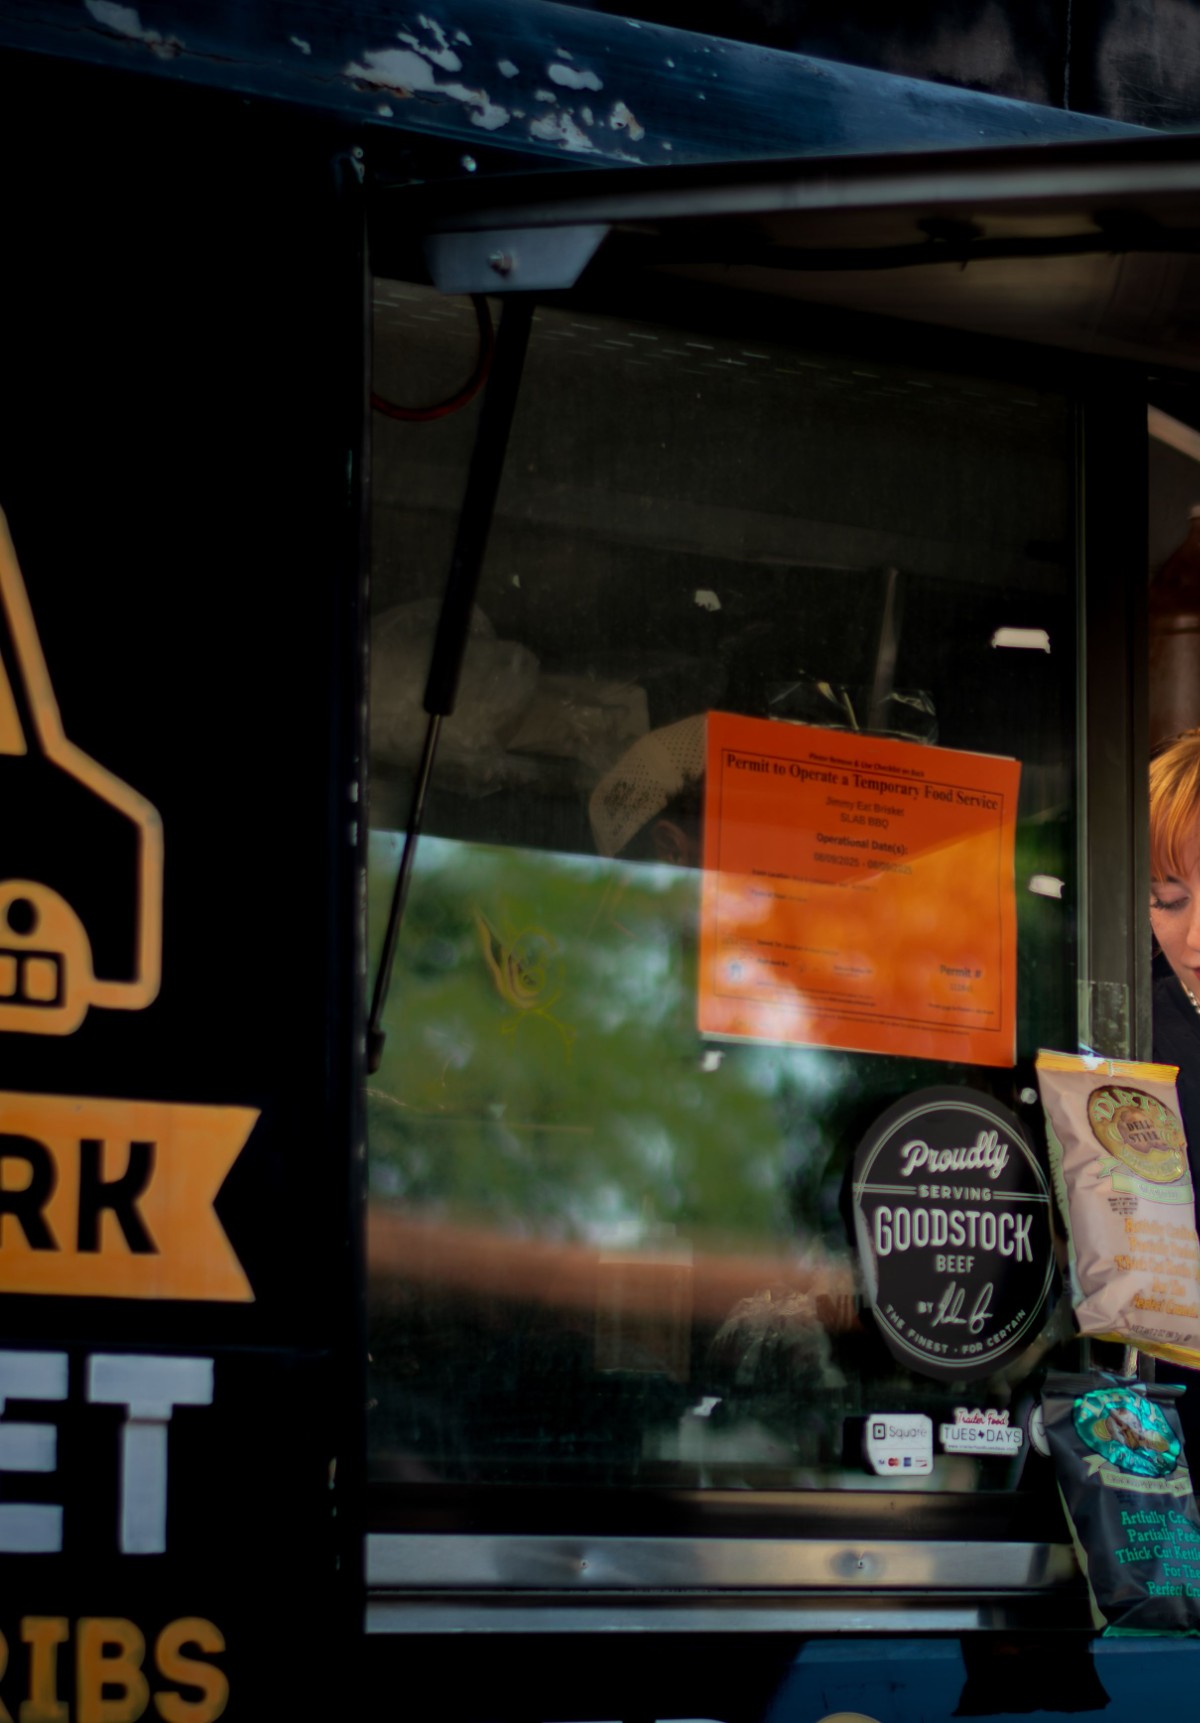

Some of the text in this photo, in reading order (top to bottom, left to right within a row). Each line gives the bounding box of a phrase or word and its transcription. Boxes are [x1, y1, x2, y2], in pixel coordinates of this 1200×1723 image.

[727, 754, 998, 810] Permit to Operate a Temporary Food Service
[857, 801, 872, 812] Eat
[874, 803, 905, 816] Brisket
[840, 813, 889, 829] SLAB BBQ
[816, 832, 909, 856] Operational Date(s):
[939, 964, 972, 977] Permit
[901, 1130, 1009, 1179] Proudly
[0, 1132, 160, 1255] RK
[918, 1184, 992, 1201] SERVING
[874, 1206, 1033, 1262] GOODSTOCK
[935, 1254, 975, 1273] BEEF
[917, 1301, 934, 1314] BY
[885, 1304, 904, 1331] THE
[908, 1328, 949, 1354] FINEST
[962, 1341, 984, 1354] FOR
[986, 1309, 1027, 1347] CERTAIN
[987, 1412, 1008, 1427] Food
[1120, 1510, 1166, 1526] Artfully
[1127, 1527, 1175, 1545] Partially
[1115, 1545, 1152, 1564] Thick
[1153, 1544, 1173, 1559] Cut
[1162, 1562, 1181, 1577] For
[1145, 1580, 1183, 1597] Perfect
[0, 1615, 230, 1723] IBS
